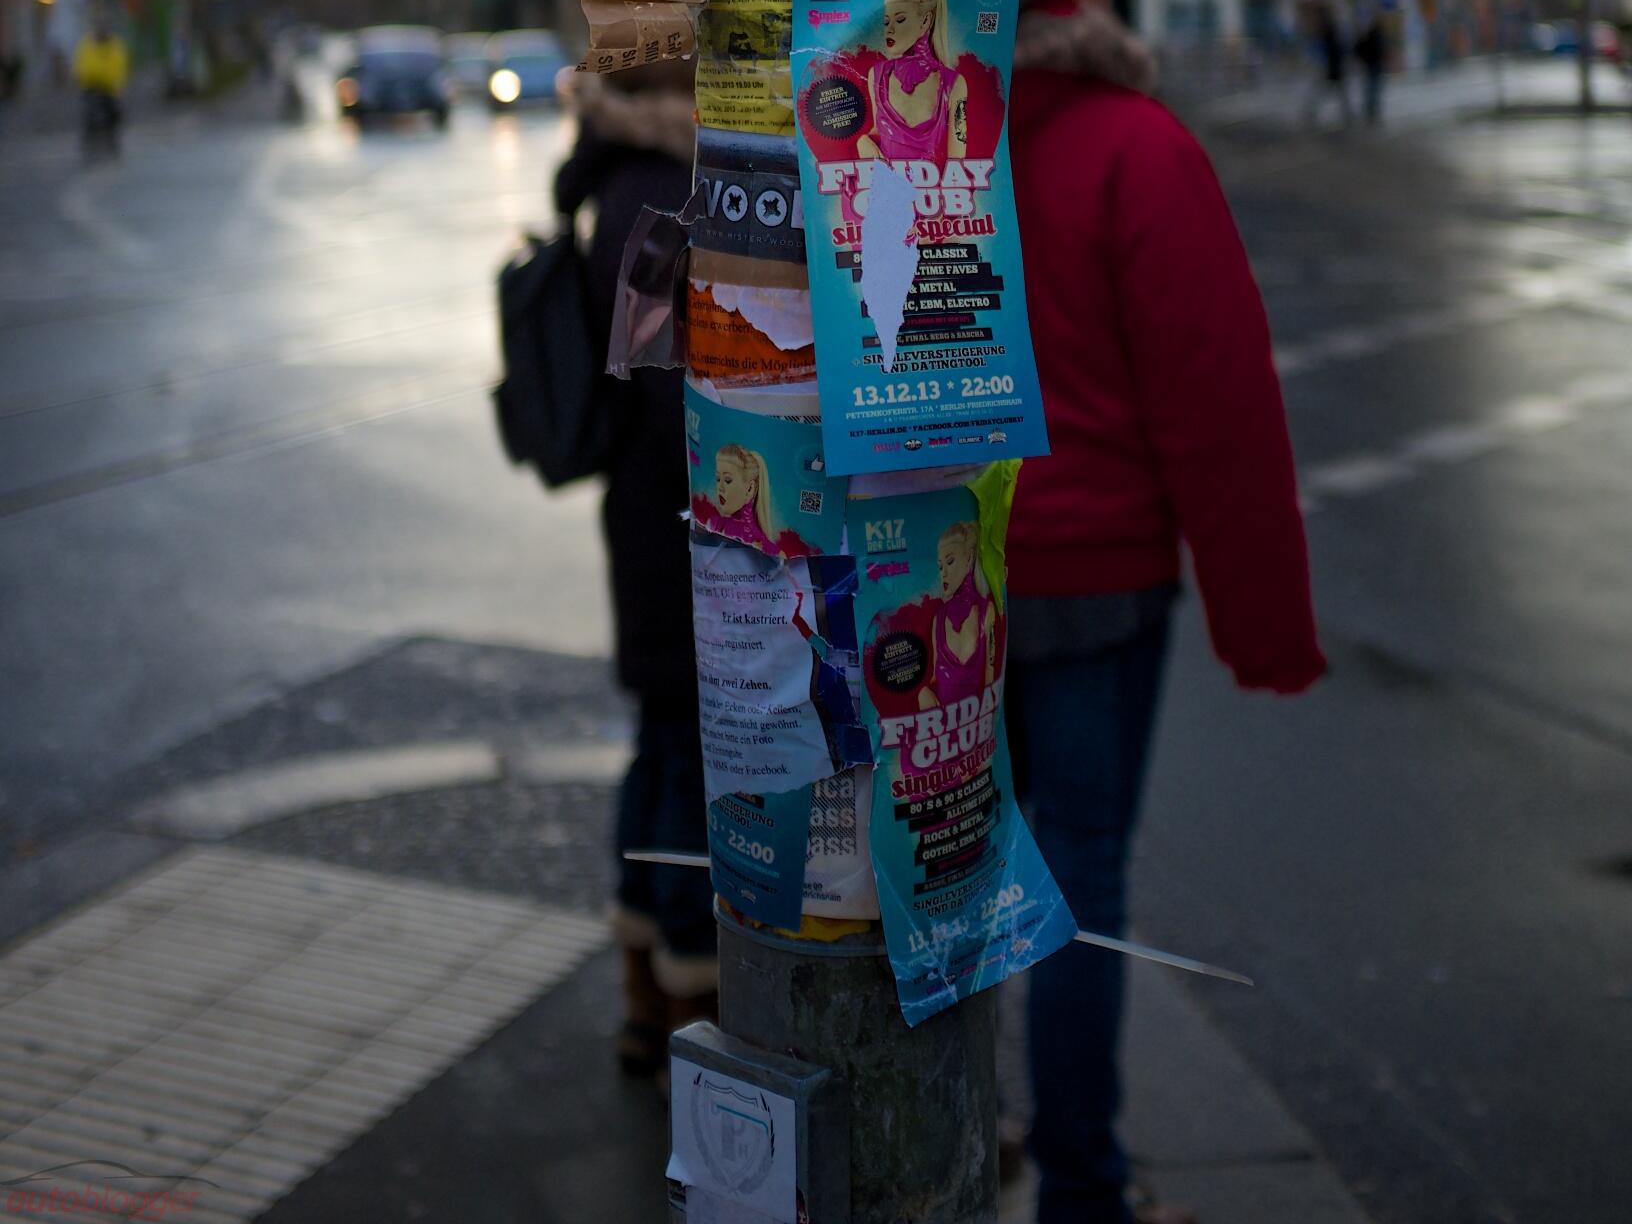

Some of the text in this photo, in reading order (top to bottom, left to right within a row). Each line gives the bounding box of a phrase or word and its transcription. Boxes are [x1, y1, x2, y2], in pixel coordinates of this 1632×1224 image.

[823, 112, 858, 126] ADMISSION
[916, 214, 998, 242] special
[923, 248, 969, 259] CLASSIX
[946, 264, 979, 275] FAVES
[919, 282, 957, 293] METAL
[920, 298, 946, 311] EBM,
[947, 297, 991, 309] ELECTRO
[741, 357, 758, 369] die
[863, 346, 1006, 365] SINLEVERSTEIGERUNG
[911, 357, 987, 373] DATINGTOOL
[852, 380, 941, 407] 13.12.13
[960, 375, 1015, 398] 22:00
[865, 519, 905, 540] K17
[745, 614, 788, 625] kastriert.
[721, 676, 738, 689] zwei
[740, 678, 772, 691] Zehen.
[760, 719, 802, 733] gewöhnt.
[752, 735, 774, 745] Foto
[911, 714, 996, 769] CLUB
[745, 764, 791, 777] Facebook.
[924, 829, 951, 845] ROCK
[728, 829, 775, 864] 22:00
[922, 841, 960, 860] GOTHIC,
[927, 903, 949, 918] UND
